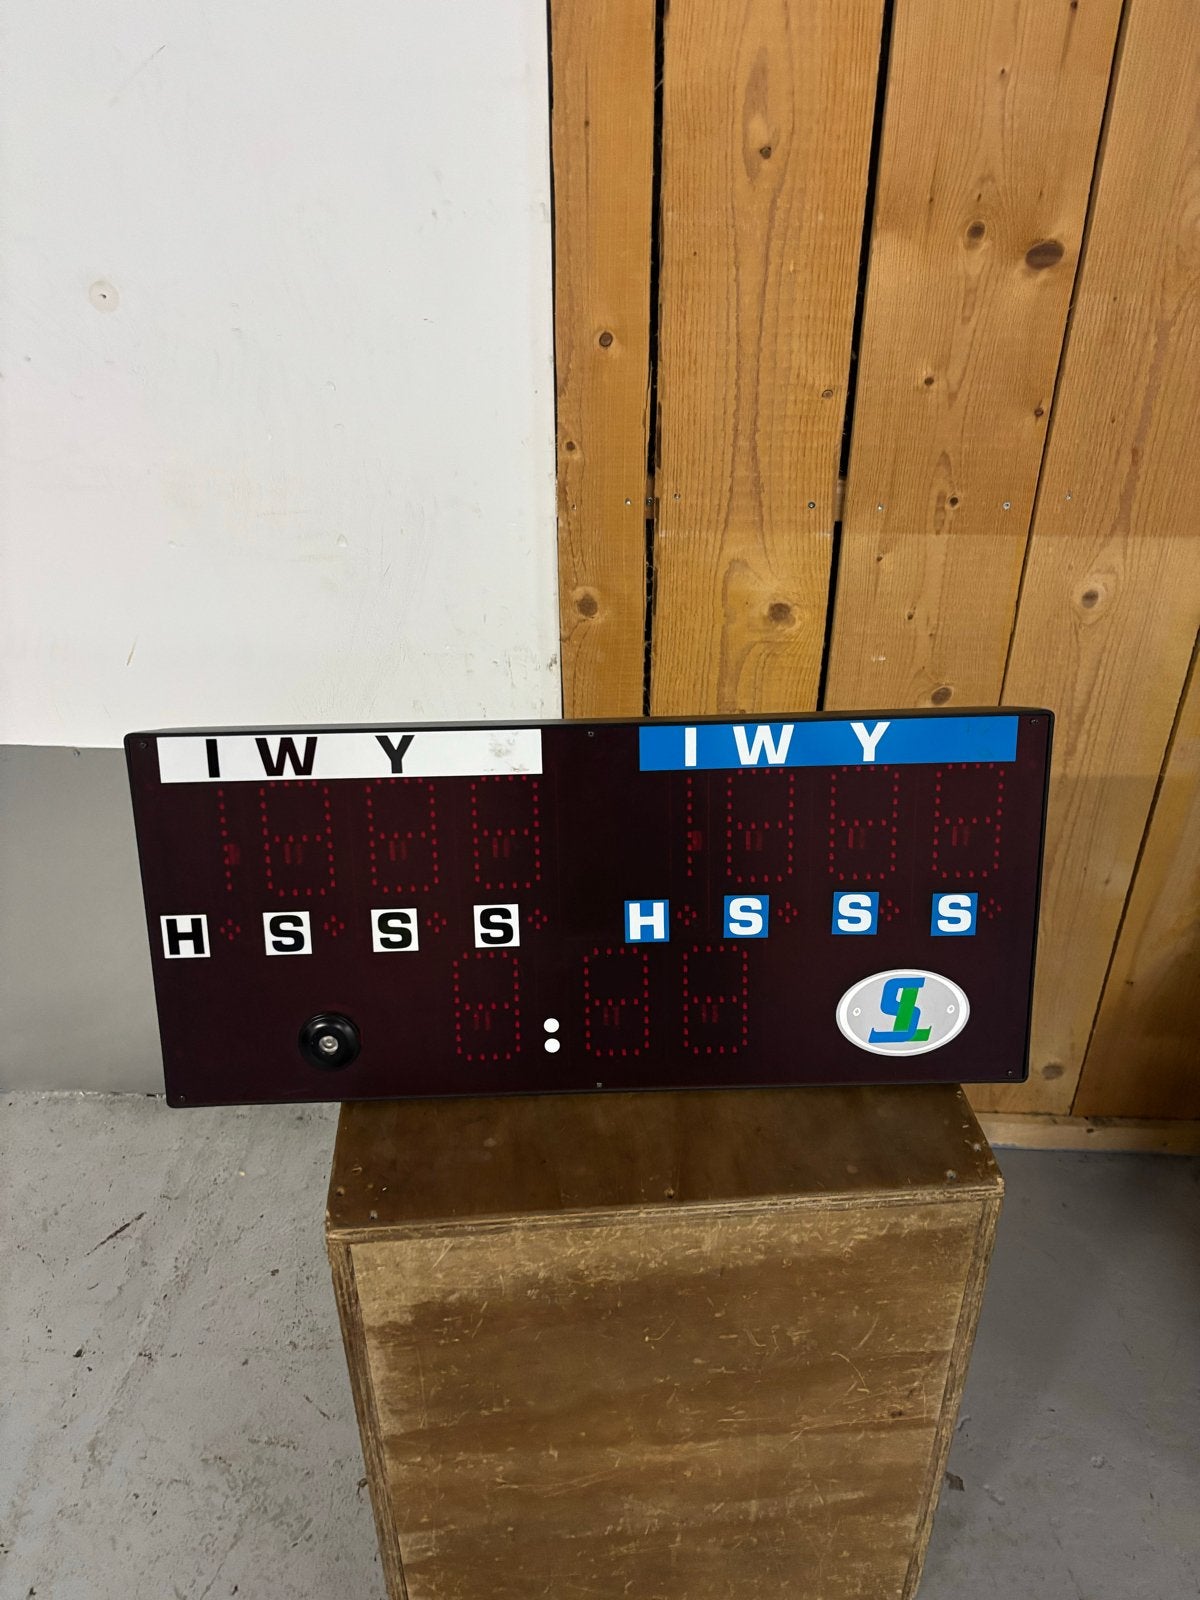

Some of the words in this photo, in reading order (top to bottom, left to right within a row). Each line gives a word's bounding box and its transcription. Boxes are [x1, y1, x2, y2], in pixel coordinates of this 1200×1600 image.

[206, 738, 220, 778] I
[255, 736, 318, 776] W
[375, 734, 415, 774] Y
[684, 727, 697, 767] I
[732, 724, 795, 765] W
[850, 721, 891, 762] Y
[166, 917, 206, 956] H
[270, 915, 305, 953] S
[377, 912, 413, 950] S
[479, 907, 514, 945] S
[628, 902, 665, 940] H
[729, 897, 763, 936] S
[837, 894, 872, 932] S
[937, 894, 972, 933] S
